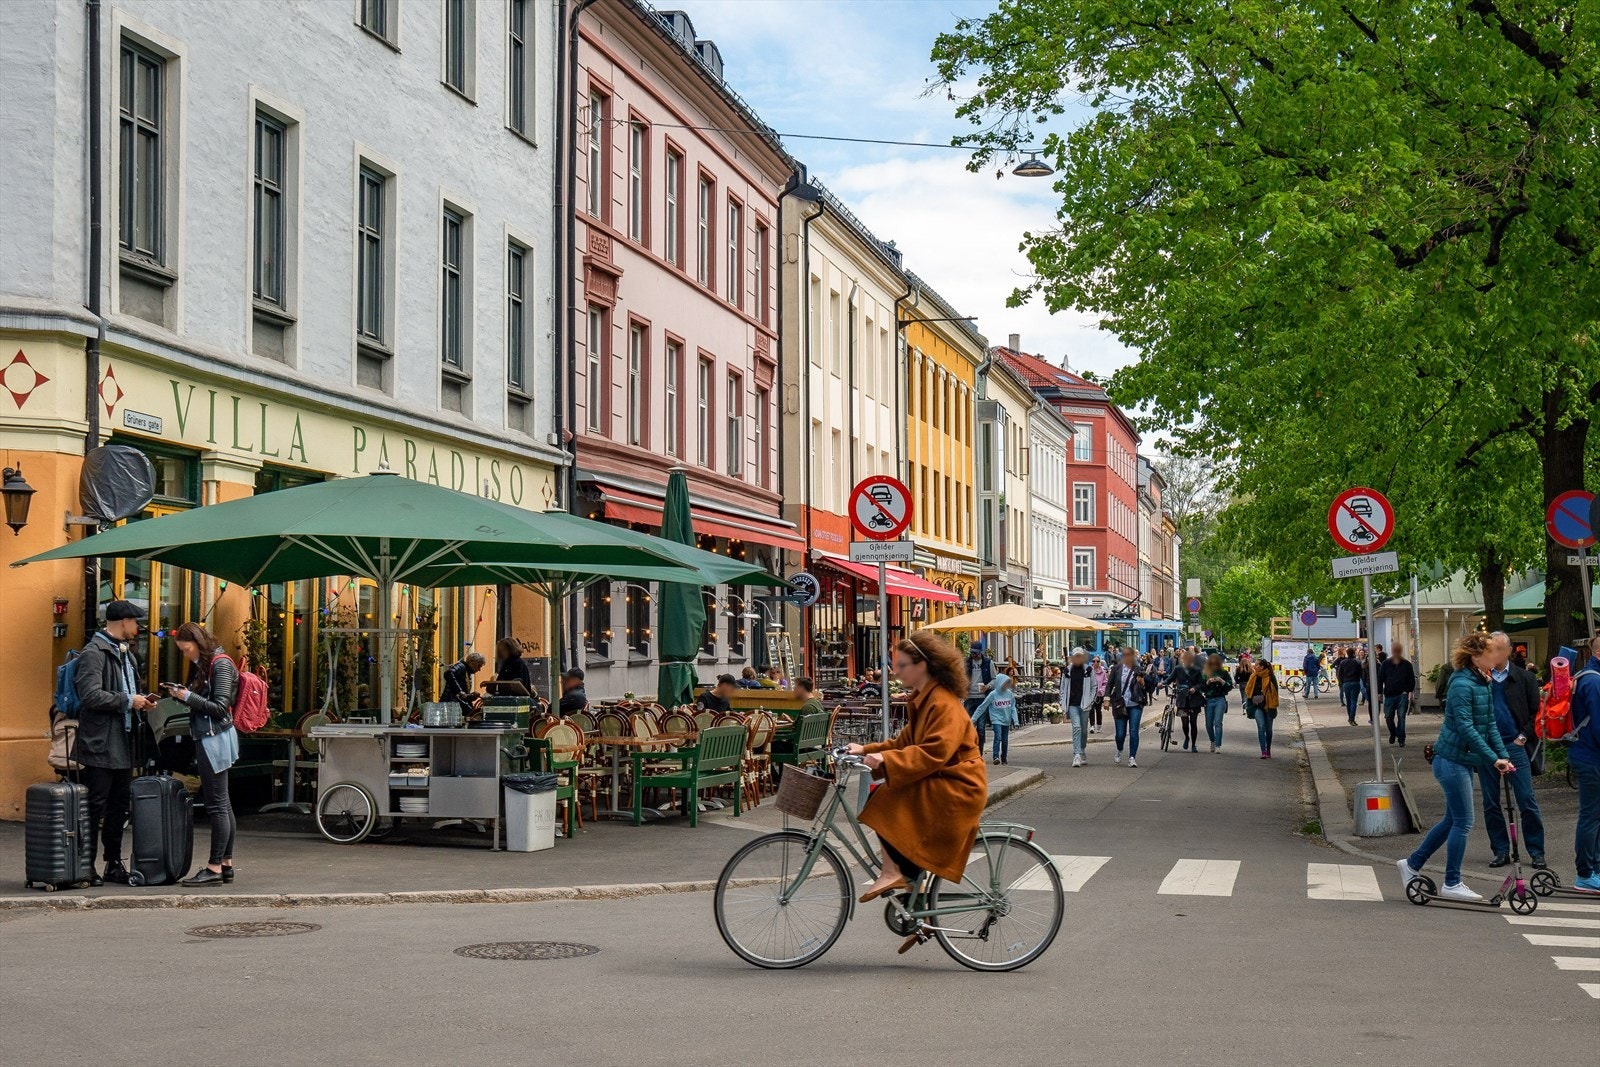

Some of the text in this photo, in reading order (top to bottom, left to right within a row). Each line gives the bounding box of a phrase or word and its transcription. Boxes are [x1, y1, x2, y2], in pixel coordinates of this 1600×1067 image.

[126, 413, 160, 431] Grüners gate
[169, 379, 524, 506] VILLA PARADISO
[869, 543, 895, 552] Gjelder
[855, 553, 909, 561] gjennomkjøring
[1351, 555, 1378, 566] Gjelder
[1338, 563, 1394, 577] gjennomkjøring
